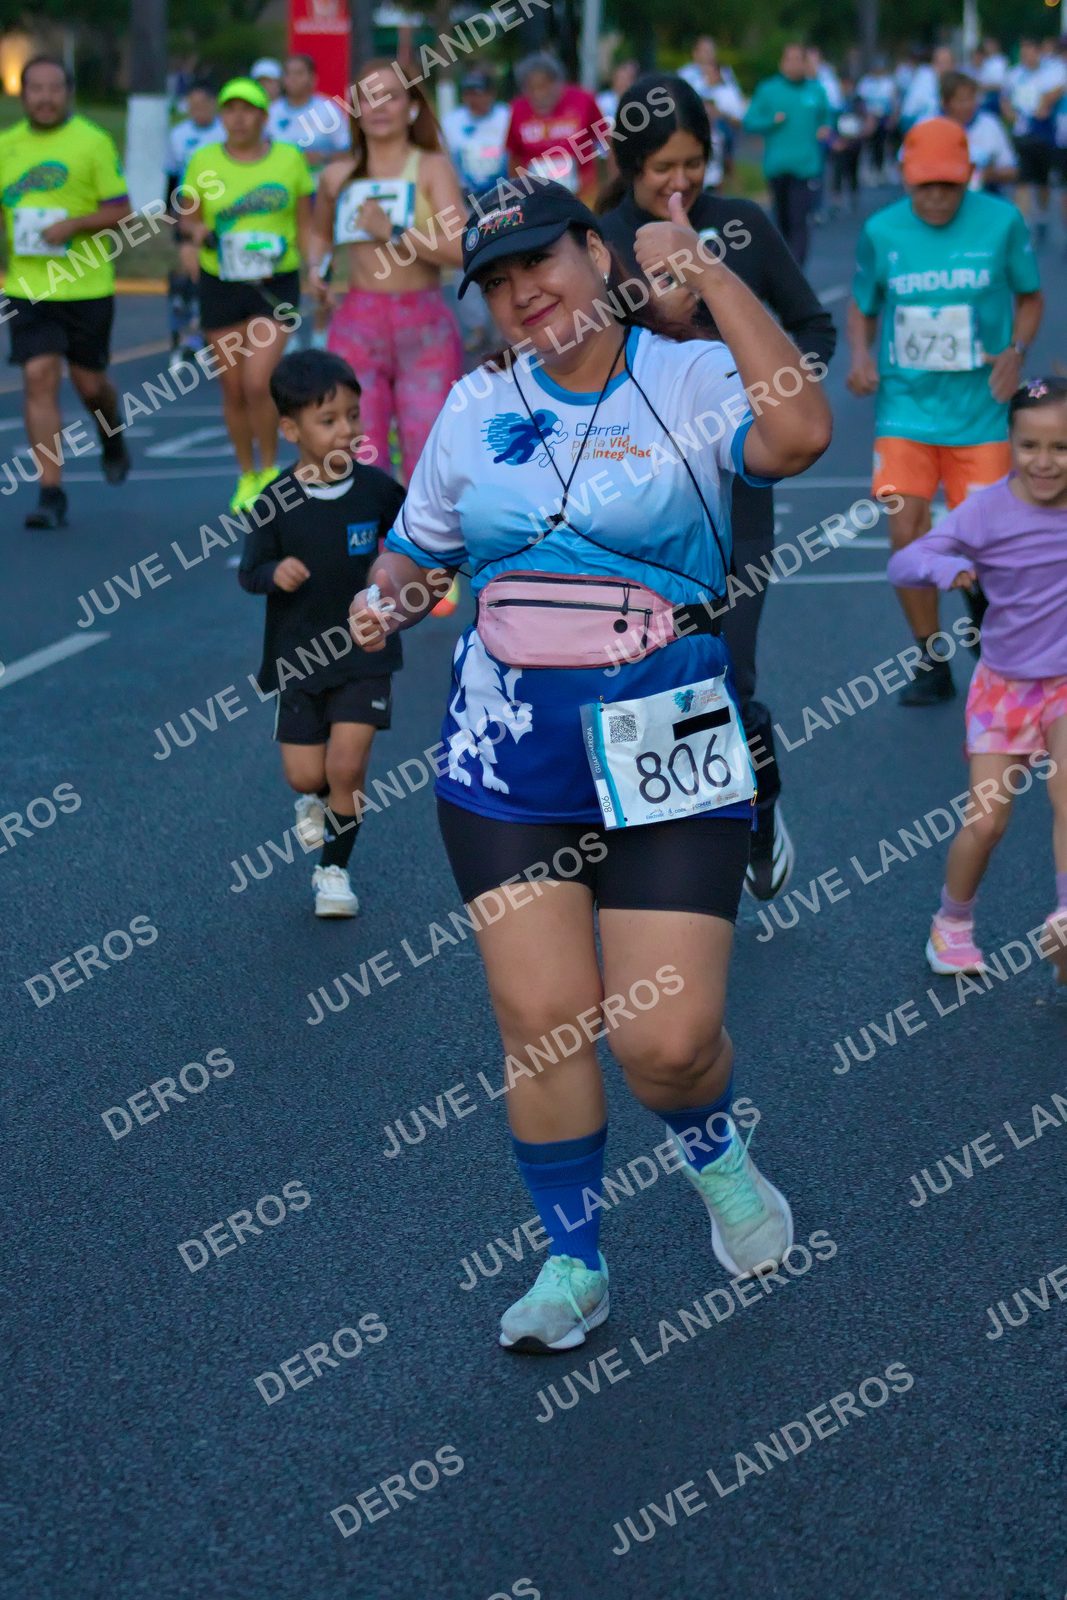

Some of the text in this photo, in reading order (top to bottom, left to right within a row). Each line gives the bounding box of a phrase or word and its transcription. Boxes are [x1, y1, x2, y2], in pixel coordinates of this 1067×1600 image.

[905, 333, 958, 361] 673
[635, 734, 731, 804] 806
[603, 795, 613, 813] 806
